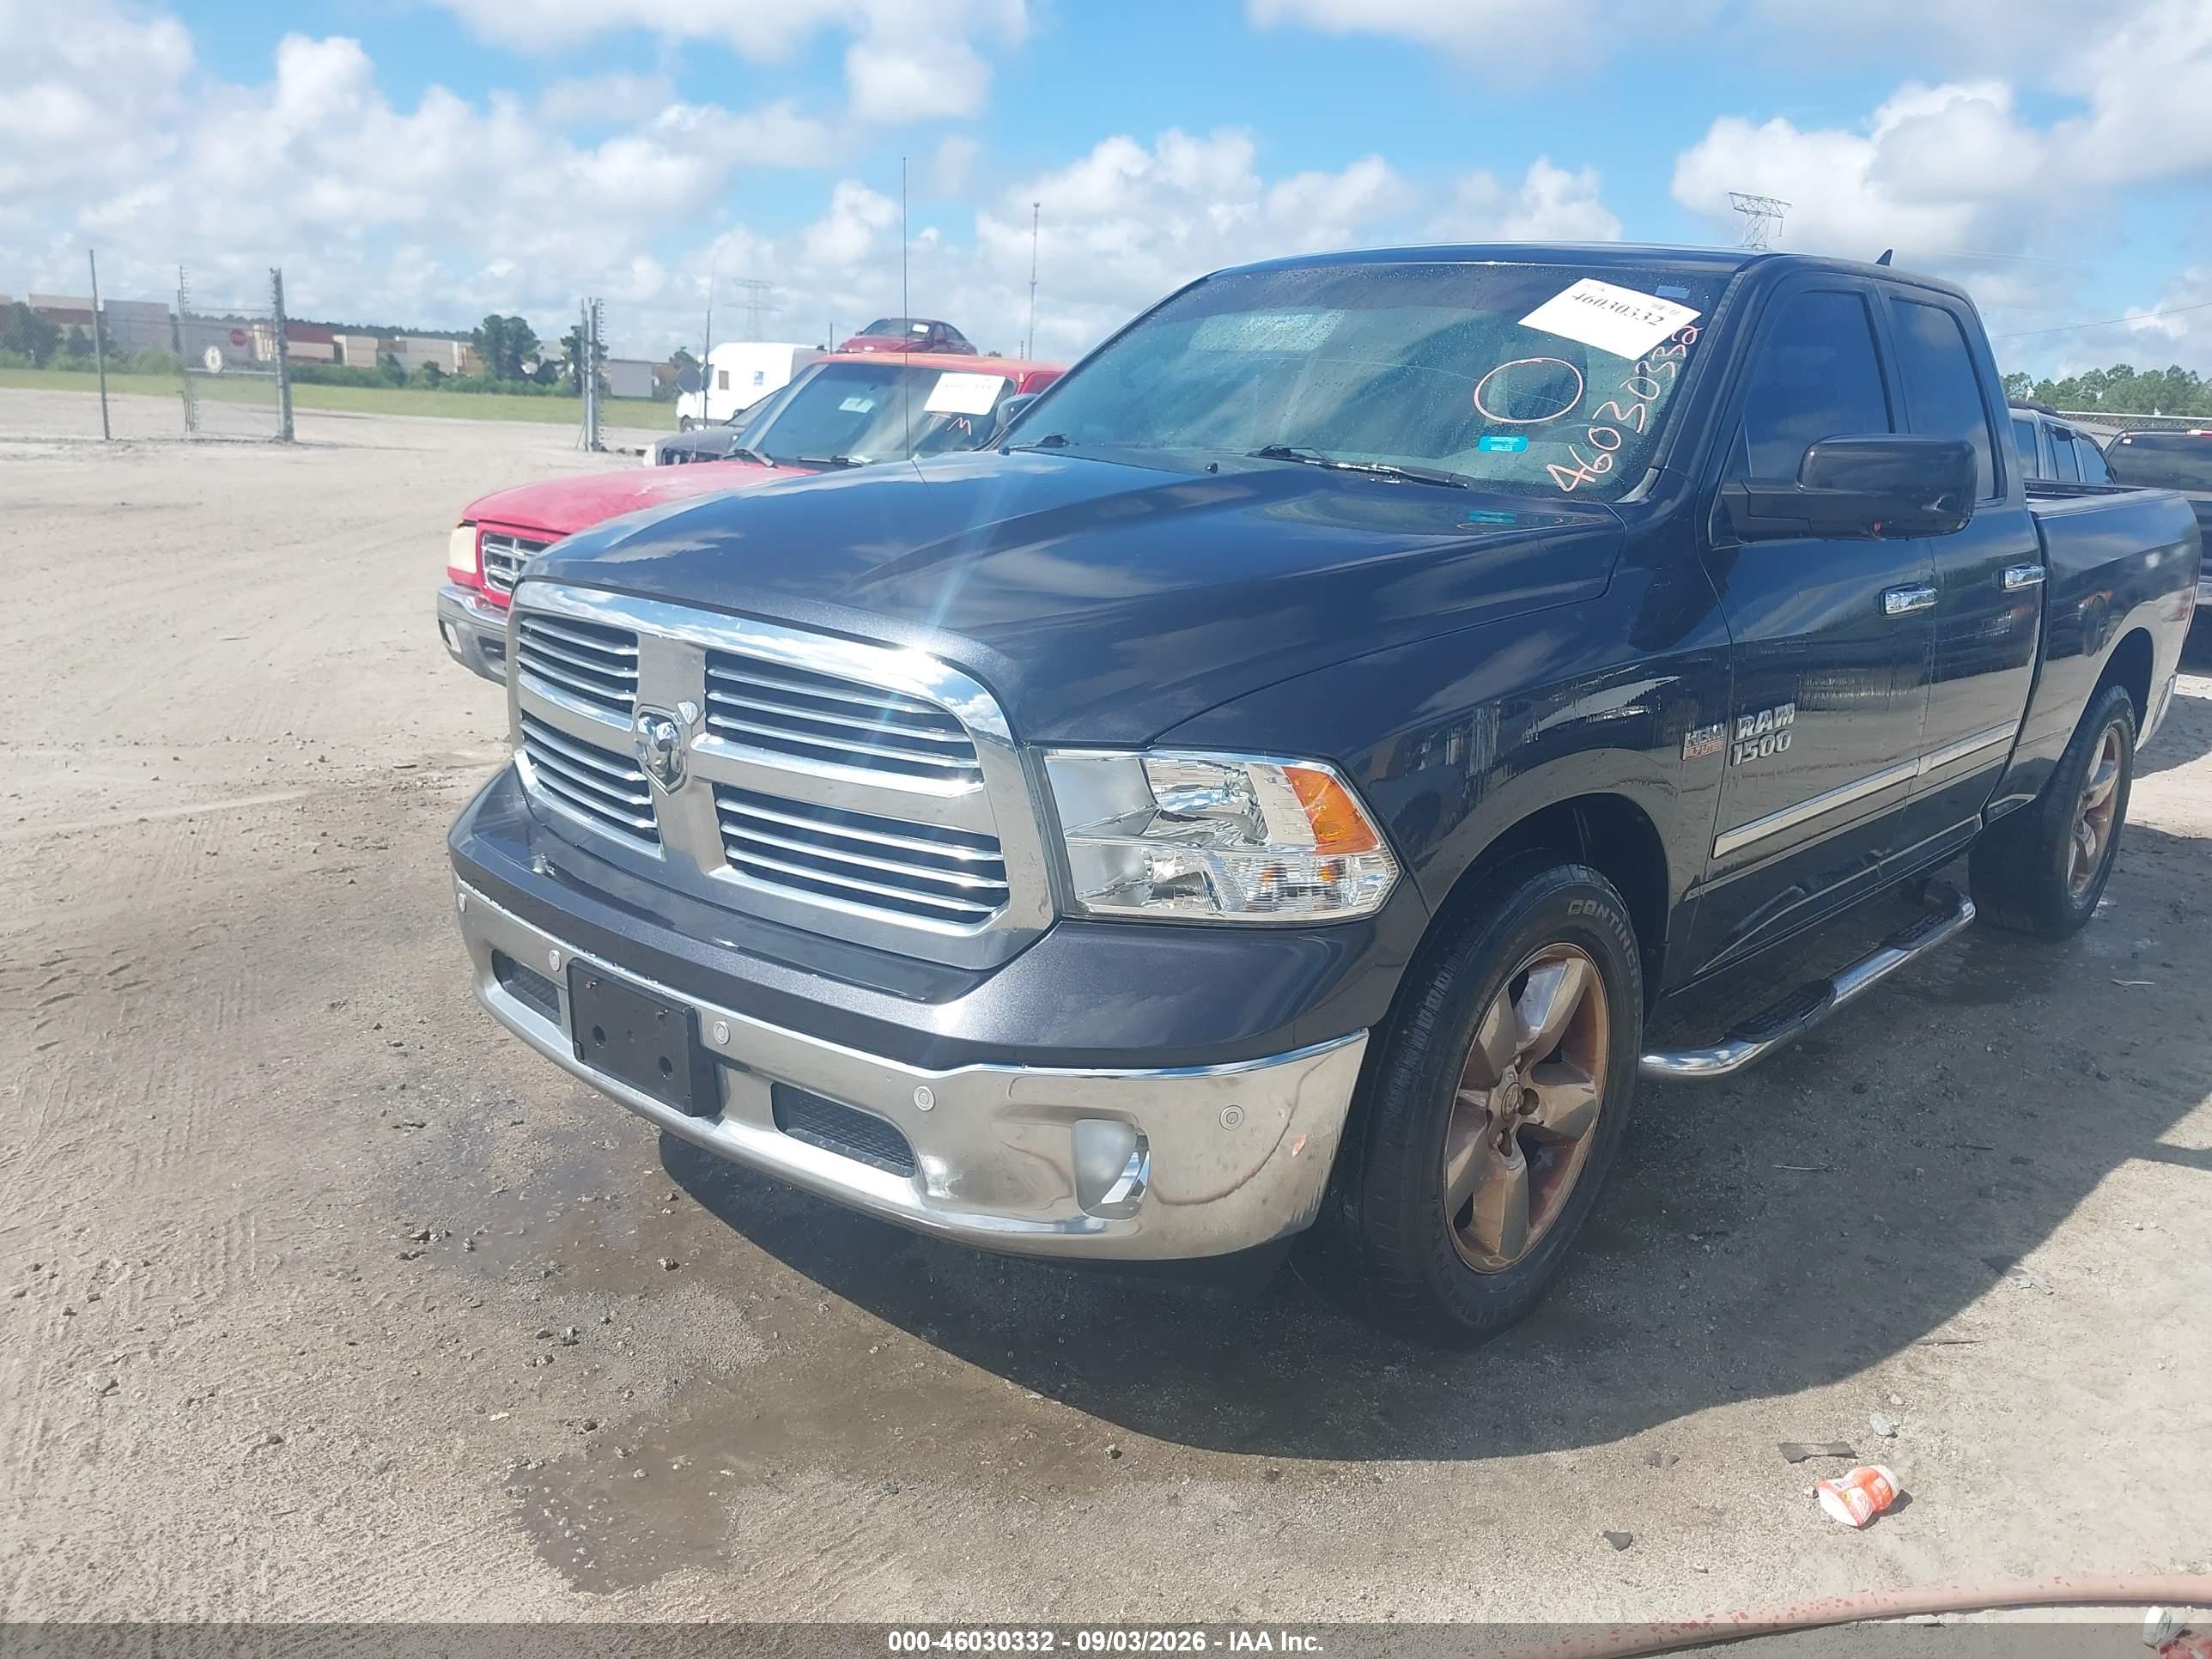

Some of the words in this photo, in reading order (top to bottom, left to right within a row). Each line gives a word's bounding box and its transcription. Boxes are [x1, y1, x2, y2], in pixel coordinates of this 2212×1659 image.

[1571, 292, 1666, 326] 46030332
[1546, 325, 1705, 493] 46030332
[1735, 702, 1796, 740] RAM
[1730, 729, 1793, 767] 1500
